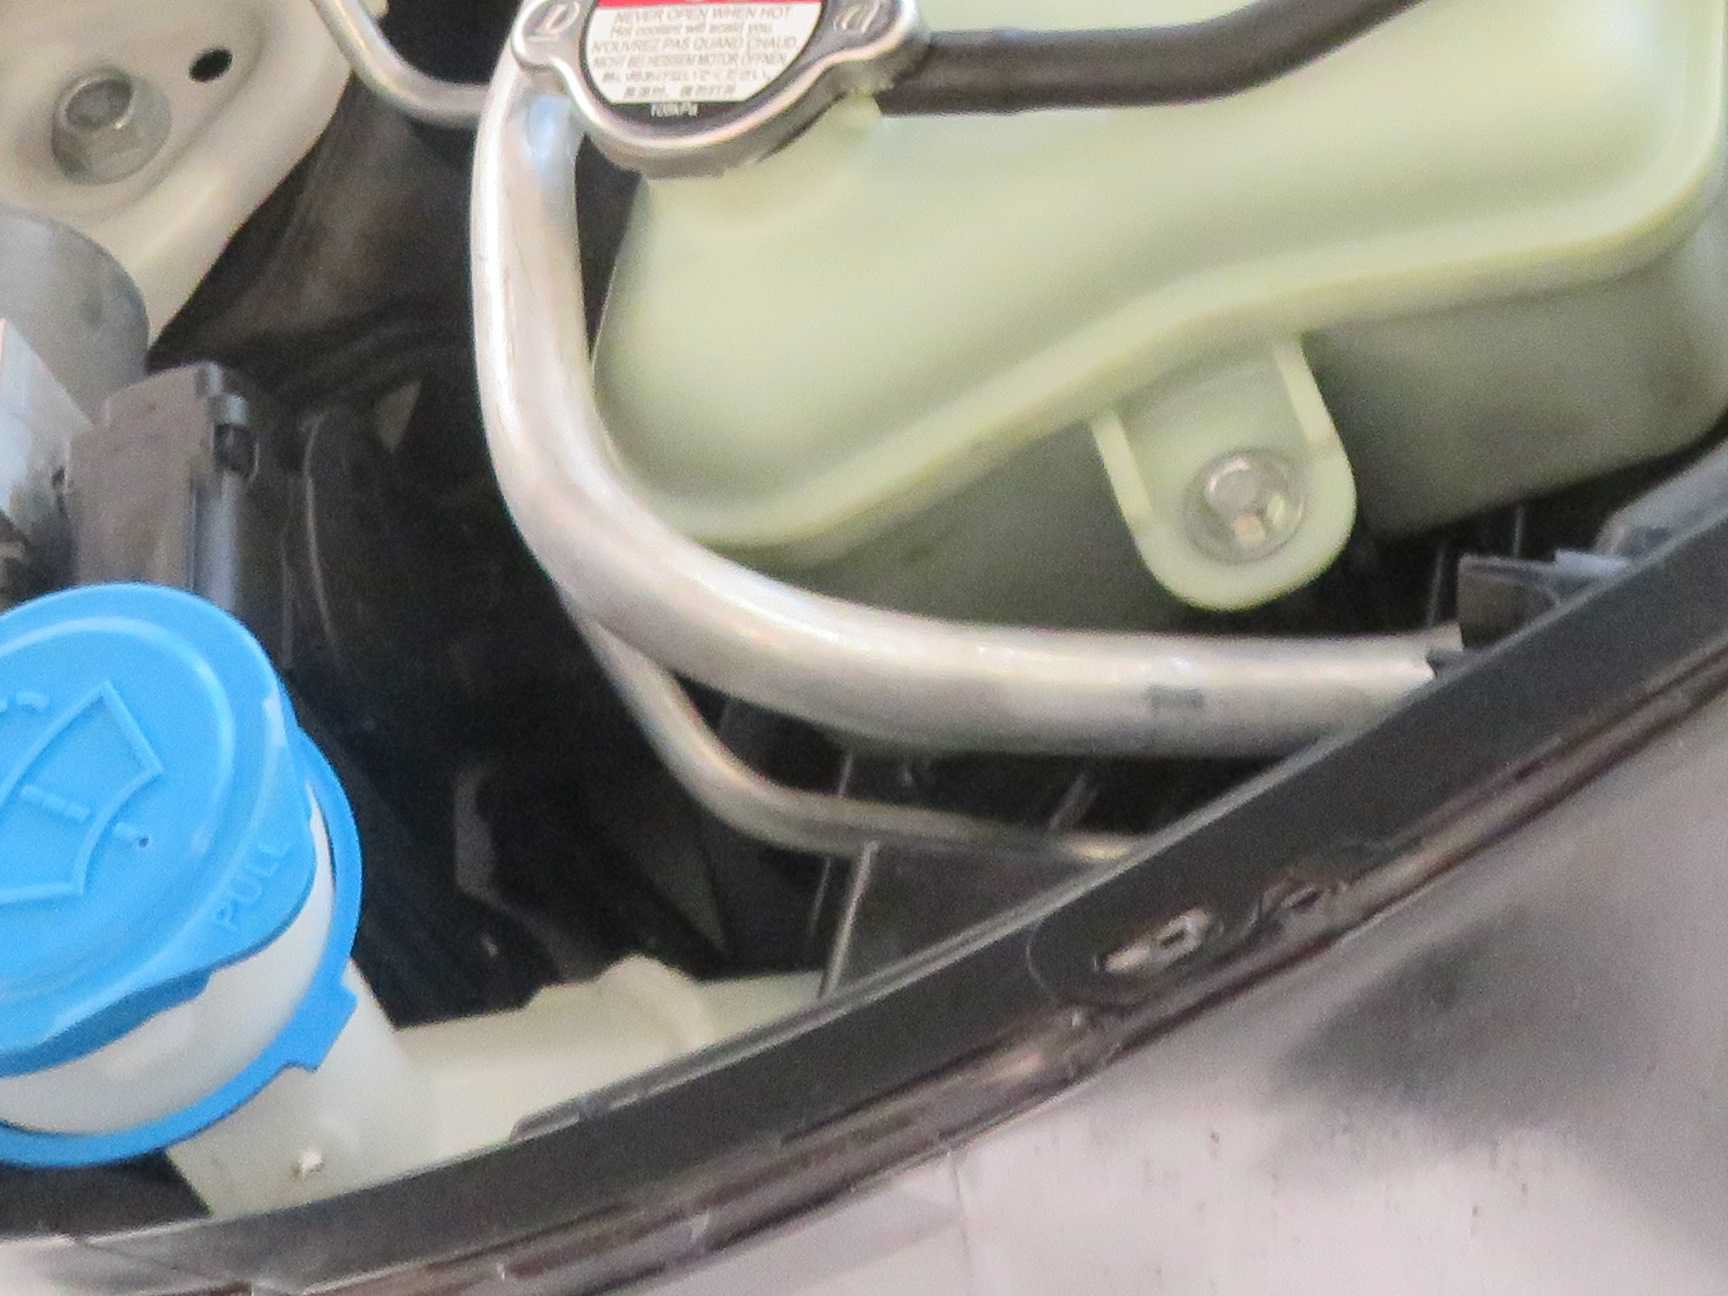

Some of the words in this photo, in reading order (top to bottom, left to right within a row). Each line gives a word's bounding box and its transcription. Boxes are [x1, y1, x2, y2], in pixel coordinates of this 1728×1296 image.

[615, 8, 664, 24] NEVER
[666, 7, 707, 23] OPEN
[712, 7, 759, 23] WHEN
[761, 6, 794, 21] HOT
[662, 38, 690, 53] PAS
[693, 36, 744, 51] QUAND
[215, 841, 294, 932] PULL
